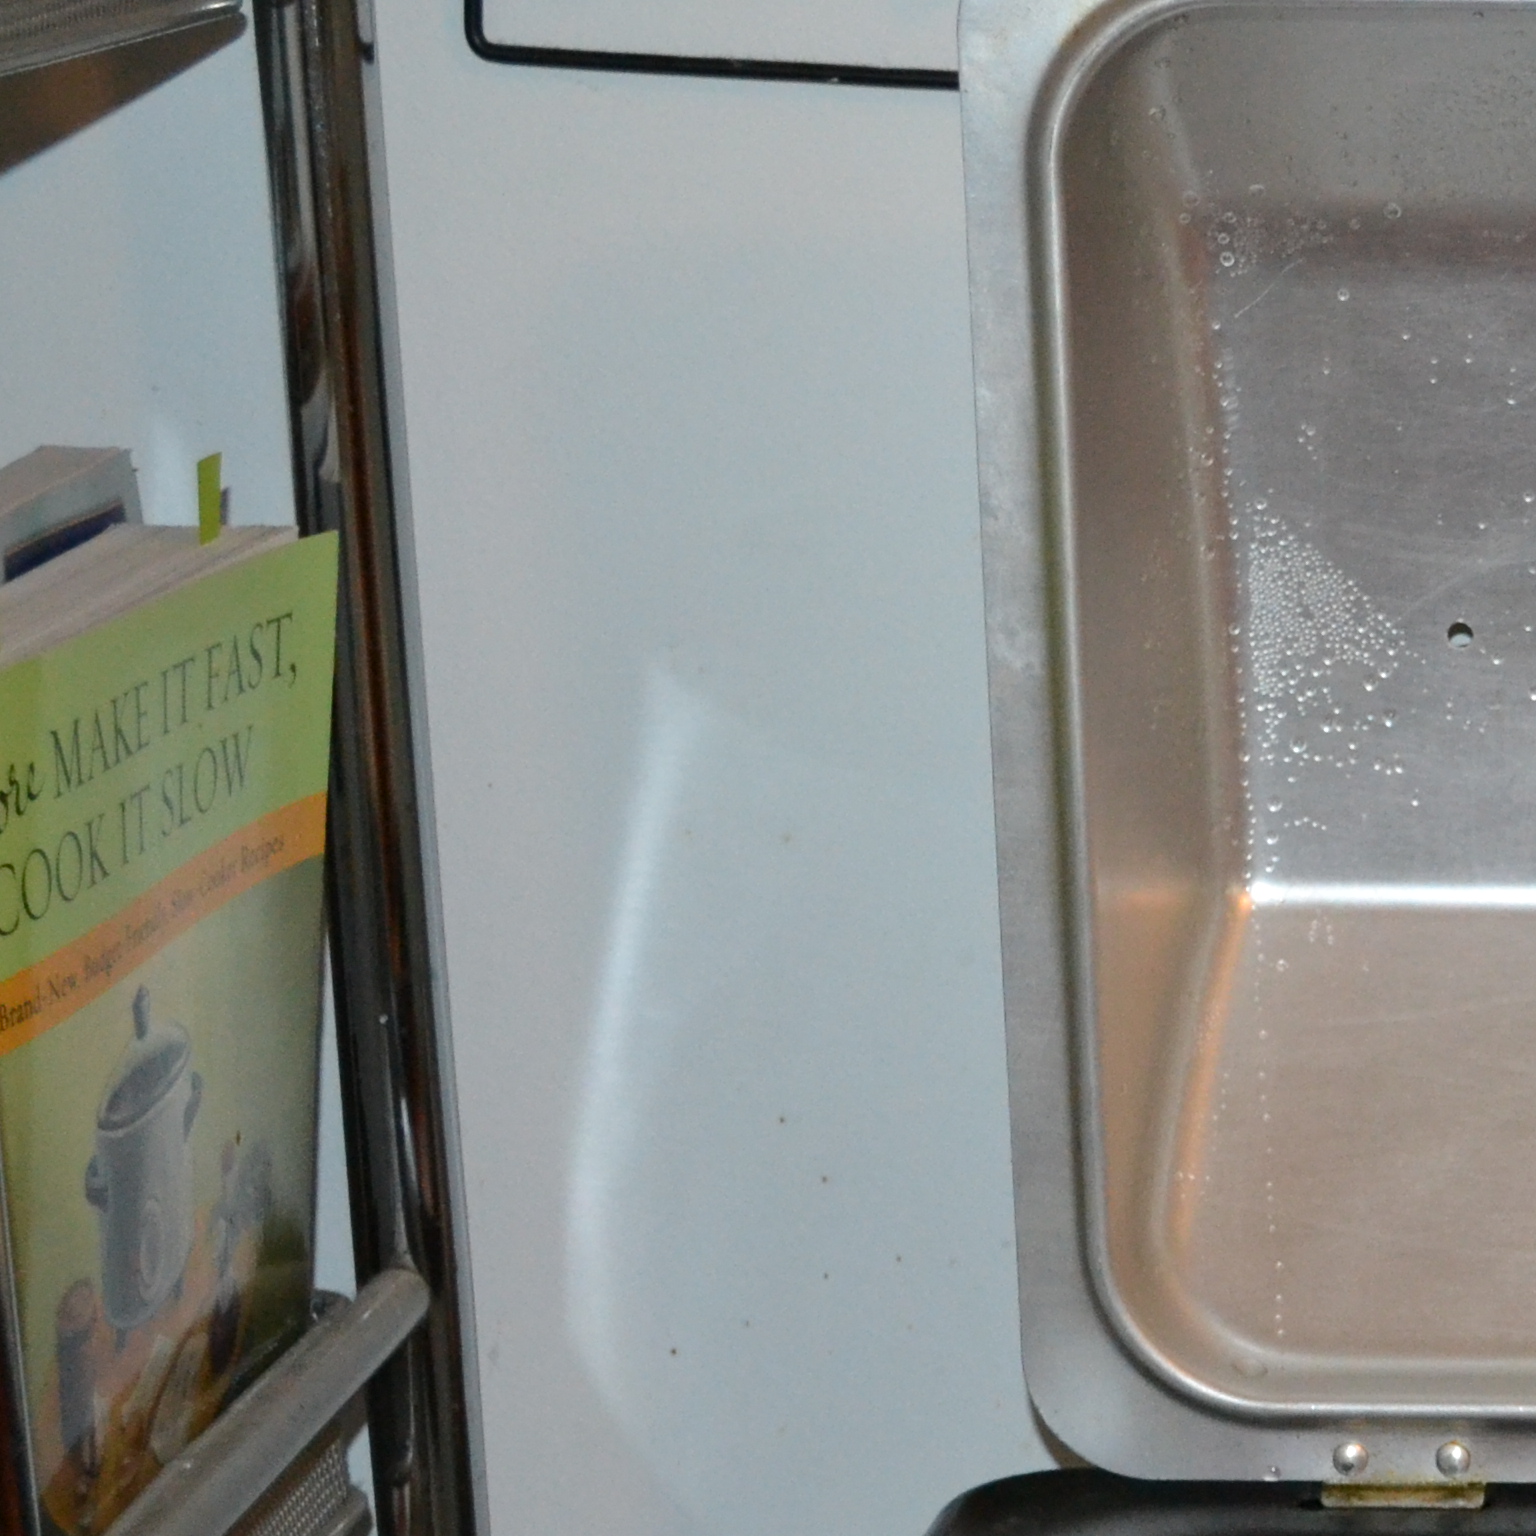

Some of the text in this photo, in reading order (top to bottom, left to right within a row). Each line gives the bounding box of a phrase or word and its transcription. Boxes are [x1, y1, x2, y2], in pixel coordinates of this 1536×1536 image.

[50, 681, 150, 799] MAKE
[161, 656, 196, 736] IT
[204, 611, 298, 712] FAST,
[0, 725, 254, 936] COOK IT SLOW
